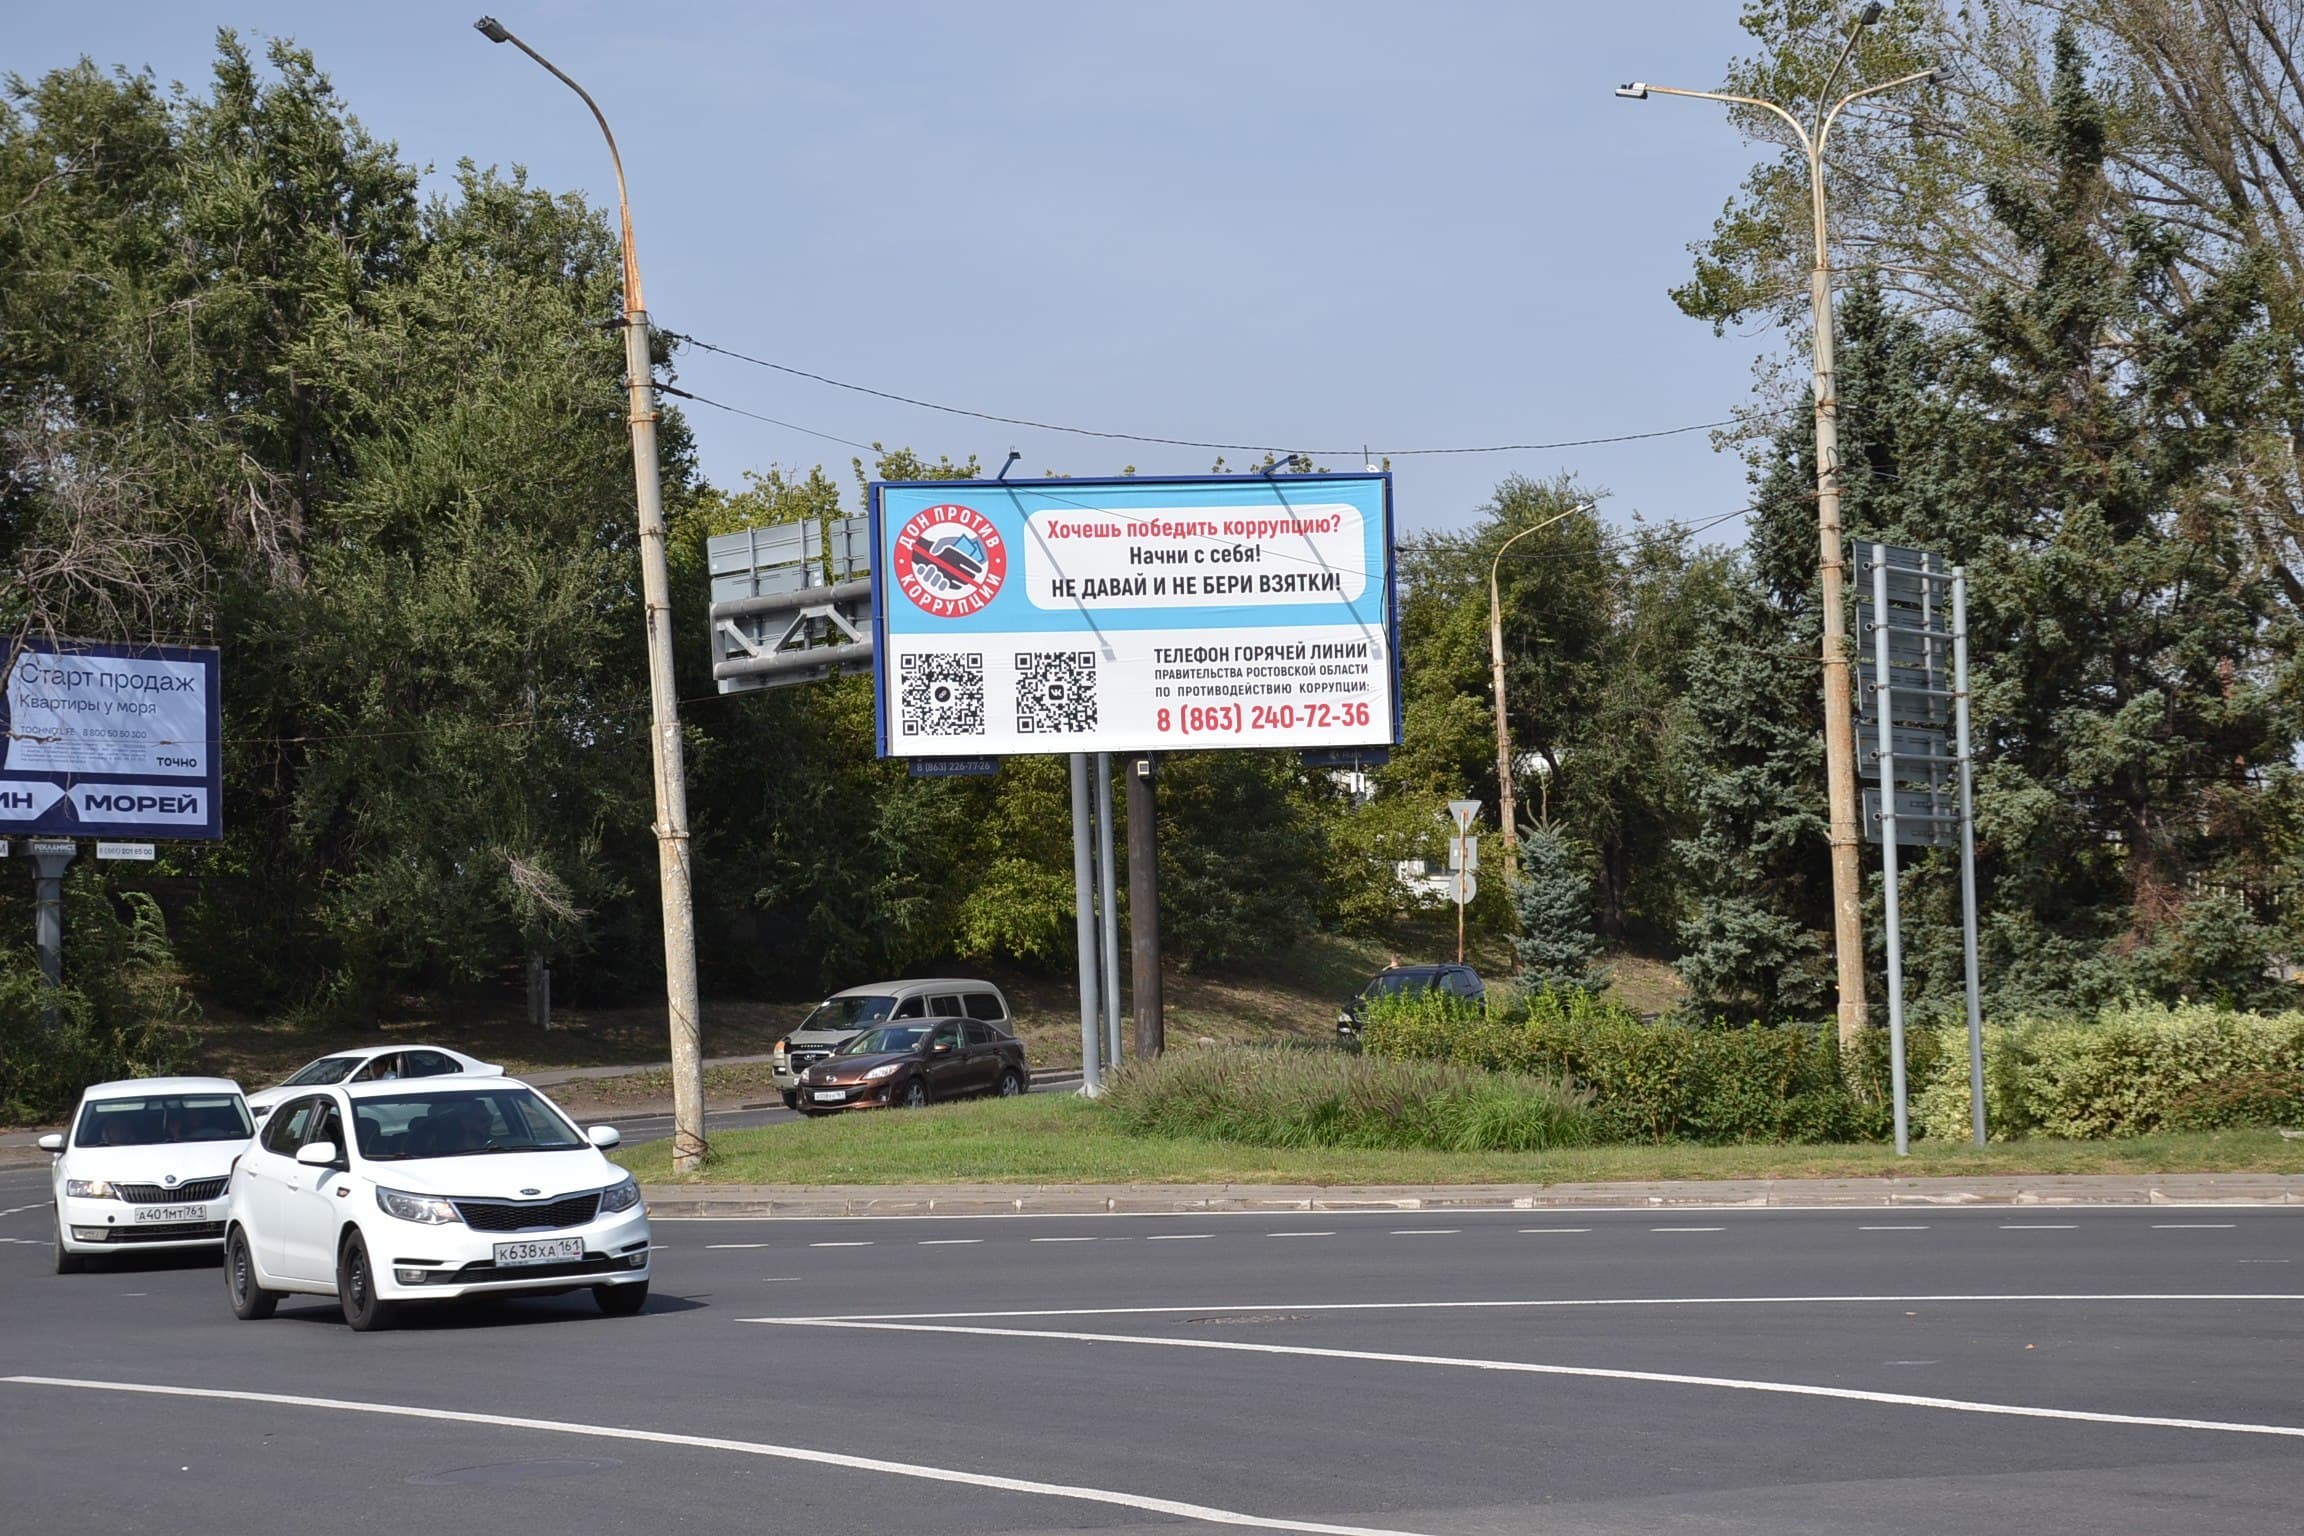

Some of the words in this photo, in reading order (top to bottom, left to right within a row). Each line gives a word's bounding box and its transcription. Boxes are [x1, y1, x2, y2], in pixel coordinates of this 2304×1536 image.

[899, 513, 930, 550] ДОН
[933, 506, 1000, 548] ПРОТИВ
[1047, 520, 1122, 539] Хочешь
[1127, 517, 1218, 539] победить
[1223, 514, 1341, 539] коррупцию?
[1129, 546, 1188, 565] Начни
[1194, 549, 1205, 563] с
[1210, 544, 1261, 563] себя!
[900, 573, 1002, 616] КОРРУПЦИИ
[1052, 578, 1077, 597] НЕ
[1081, 572, 1147, 600] ДАВАЙ
[1153, 577, 1166, 595] И
[1173, 576, 1197, 595] НЕ
[1203, 575, 1253, 594] БЕРИ
[1259, 573, 1341, 593] ВЗЯТКИ!
[1154, 646, 1230, 664] ТЕЛЕФОН
[1234, 641, 1306, 662] ГОРЯЧЕЙ
[1310, 643, 1368, 660] ЛИНИИ
[20, 662, 94, 691] Старт
[100, 671, 196, 694] продаж
[1154, 667, 1243, 680] ПРАВИТЕЛЬСТВА
[1246, 663, 1317, 678] РОСТОВСКОЙ
[1319, 663, 1369, 675] ОБЛАСТИ
[1155, 686, 1170, 698] ПО
[1177, 682, 1292, 697] ПРОТИВОДЕЙСТВИЮ
[1299, 681, 1370, 694] КОРРУПЦИИ:
[19, 693, 100, 713] Квартиры
[104, 701, 113, 715] у
[116, 702, 157, 716] моря
[1157, 708, 1171, 732] 8
[1180, 703, 1242, 735] (863)
[1251, 702, 1370, 729] 240-72-36
[916, 763, 923, 772] 8
[925, 762, 947, 772] (863)
[84, 793, 198, 814] МОРЕЙ
[138, 1208, 184, 1220] А401МТ
[499, 1244, 556, 1260] К638ХА
[558, 1239, 579, 1251] 161
